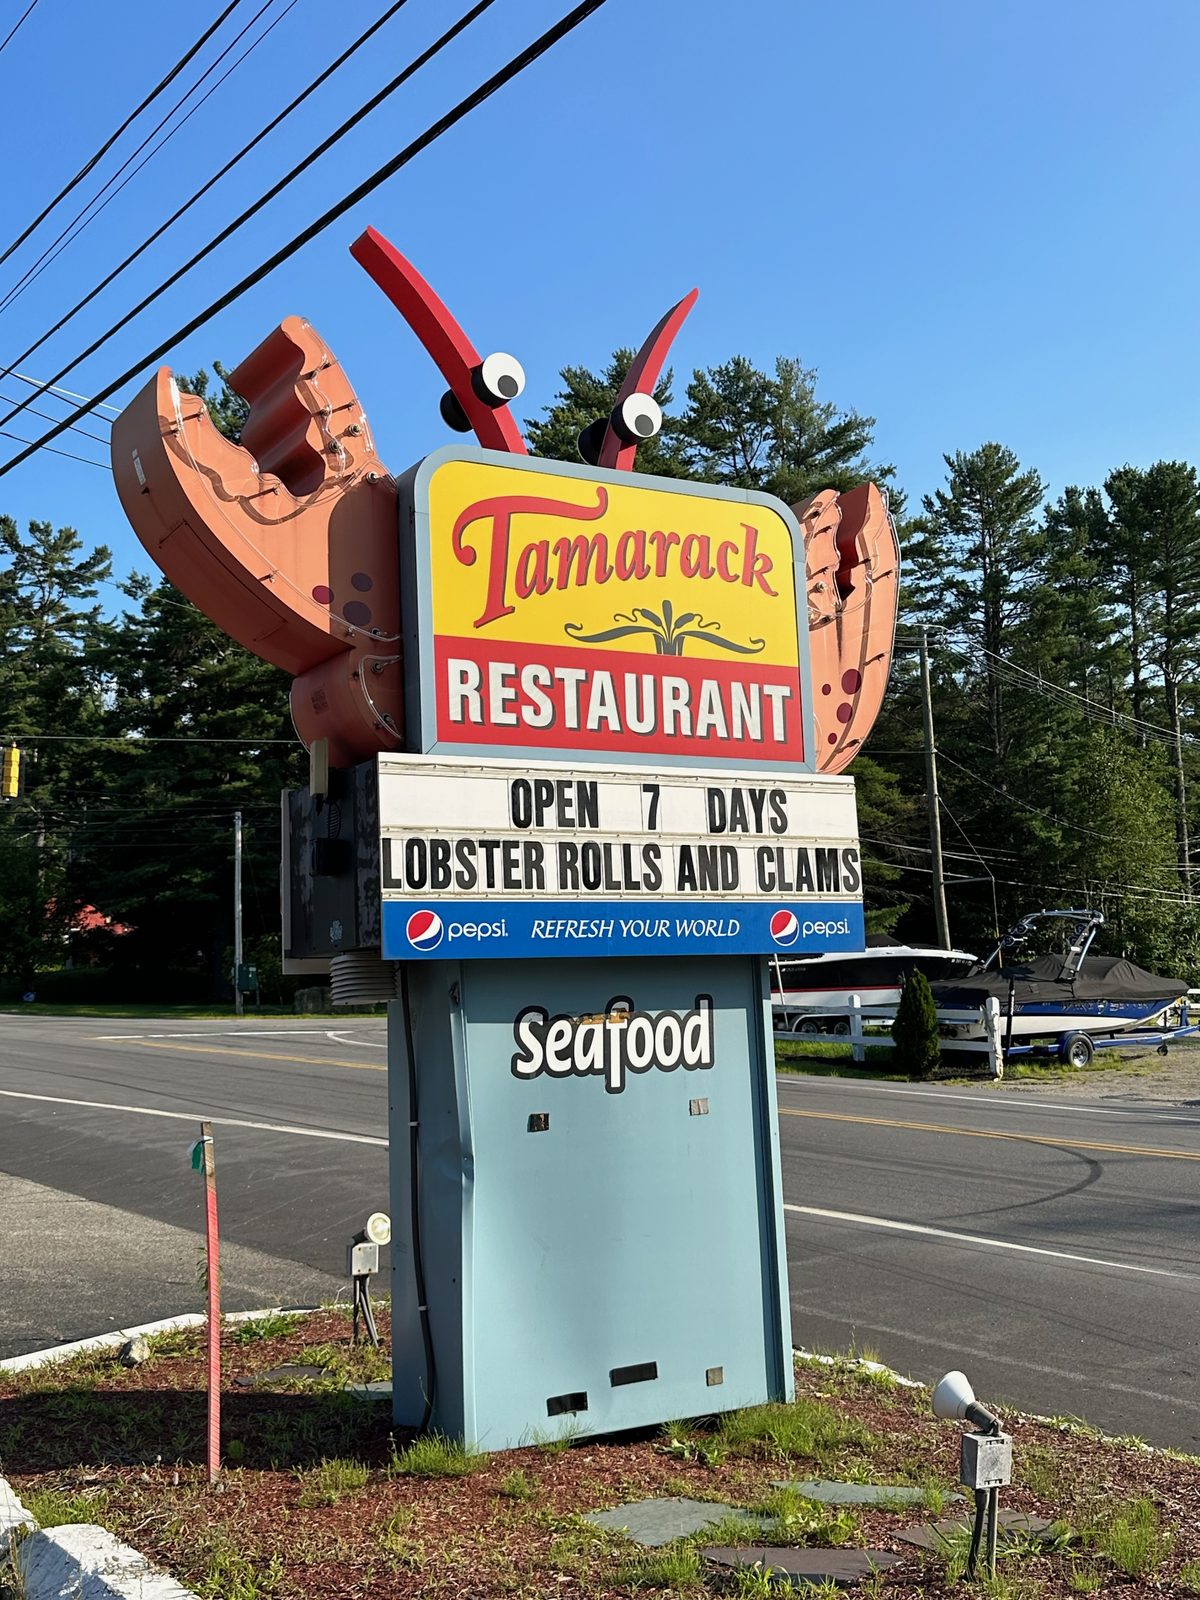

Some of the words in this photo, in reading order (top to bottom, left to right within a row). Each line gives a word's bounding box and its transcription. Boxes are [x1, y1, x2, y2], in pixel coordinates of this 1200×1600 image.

[451, 486, 779, 629] Tamarack
[447, 658, 792, 744] RESTAURANT
[510, 778, 599, 829] OPEN
[642, 784, 661, 830] 7
[708, 788, 788, 834] DAYS
[382, 837, 545, 890] LOBSTER
[559, 840, 662, 892] ROLLS
[677, 845, 739, 892] AND
[757, 846, 860, 894] CLAMS
[448, 919, 509, 941] pepsi
[531, 920, 615, 940] REFRESH
[619, 919, 680, 938] YOUR
[680, 919, 740, 938] WORLD
[802, 918, 851, 939] pepsi
[514, 997, 712, 1090] Seafood
